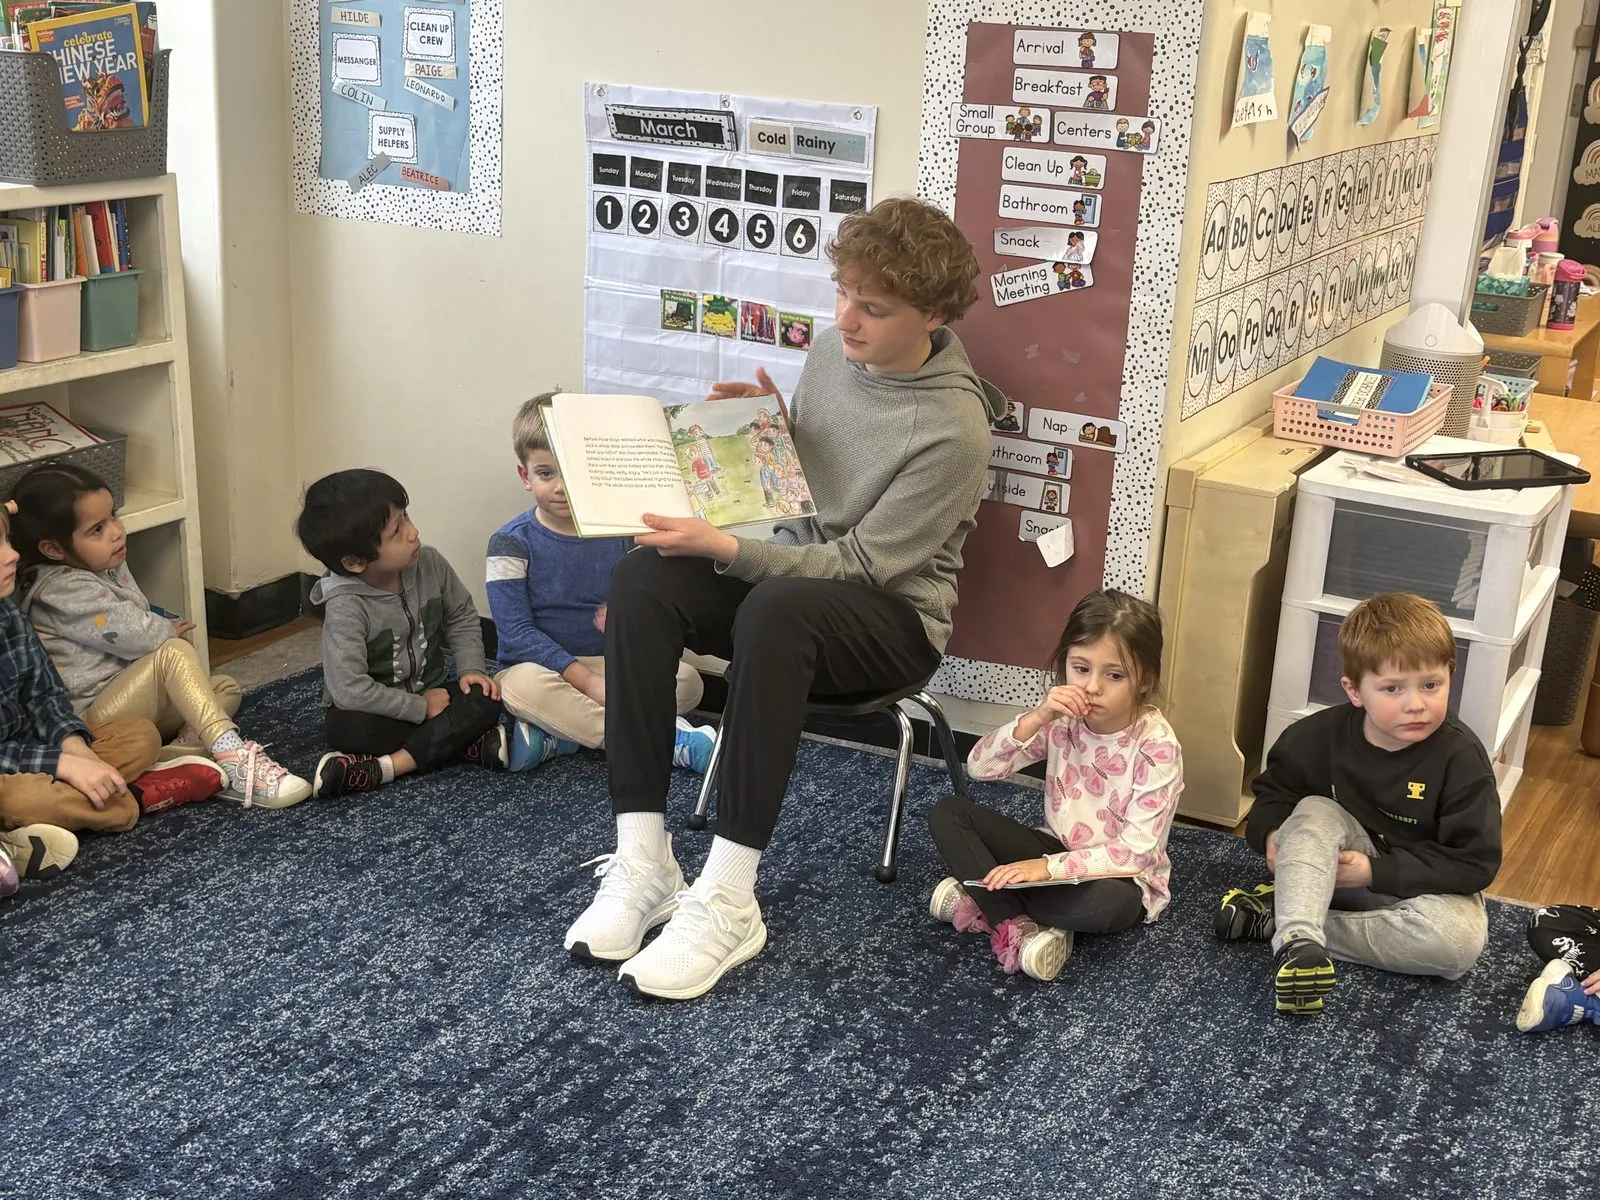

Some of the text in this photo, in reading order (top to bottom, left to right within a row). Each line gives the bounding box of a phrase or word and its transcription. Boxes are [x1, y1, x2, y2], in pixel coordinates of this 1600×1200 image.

[341, 11, 369, 24] HILDE
[410, 21, 450, 33] CLEAN UP
[63, 30, 113, 48] celebrate
[419, 35, 444, 46] CREW
[1016, 38, 1064, 54] Arrival
[47, 39, 116, 67] HINESE
[337, 56, 377, 66] MESSANGER
[94, 52, 138, 75] YEAR
[414, 63, 443, 77] PAIGE
[341, 84, 374, 107] COLIN
[406, 78, 446, 103] LEONARDO
[1015, 77, 1083, 96] Breakfast
[959, 104, 994, 120] Small
[378, 125, 405, 137] SUPPLY
[639, 119, 698, 139] March
[956, 119, 996, 138] Group
[1057, 121, 1112, 139] Centers
[378, 138, 409, 150] HELPERS
[757, 131, 837, 155] Cold Rainy
[358, 164, 379, 186] ALEC
[1005, 155, 1064, 177] Clean Up
[401, 166, 440, 186] BEATRICE
[599, 166, 862, 204] Sunday Monday Tuesday Wednesday Thursday Friday Saturday
[1002, 194, 1068, 215] Bathroom
[604, 201, 807, 249] 1 2 3 4 5 6
[1205, 220, 1225, 255] Aa
[1231, 215, 1248, 250] Bb
[1256, 207, 1274, 241] Cc
[1278, 199, 1295, 234] Dd
[1301, 195, 1313, 226] Ee
[1322, 186, 1333, 218] Ff
[1338, 181, 1352, 215] Gg
[1356, 177, 1368, 206] Hh
[1000, 233, 1040, 249] Snack
[993, 268, 1048, 288] Morning
[996, 282, 1050, 302] Meeting
[1190, 342, 1209, 379] Nn
[1218, 331, 1236, 364] Oo
[1243, 318, 1260, 355] Pp
[1265, 306, 1282, 339] Qq
[1288, 300, 1300, 330] Rr
[1308, 290, 1319, 319] Ss
[1328, 283, 1336, 312] Tt
[1343, 276, 1355, 304] Uu
[1043, 417, 1068, 435] Nap
[992, 446, 1042, 465] throom
